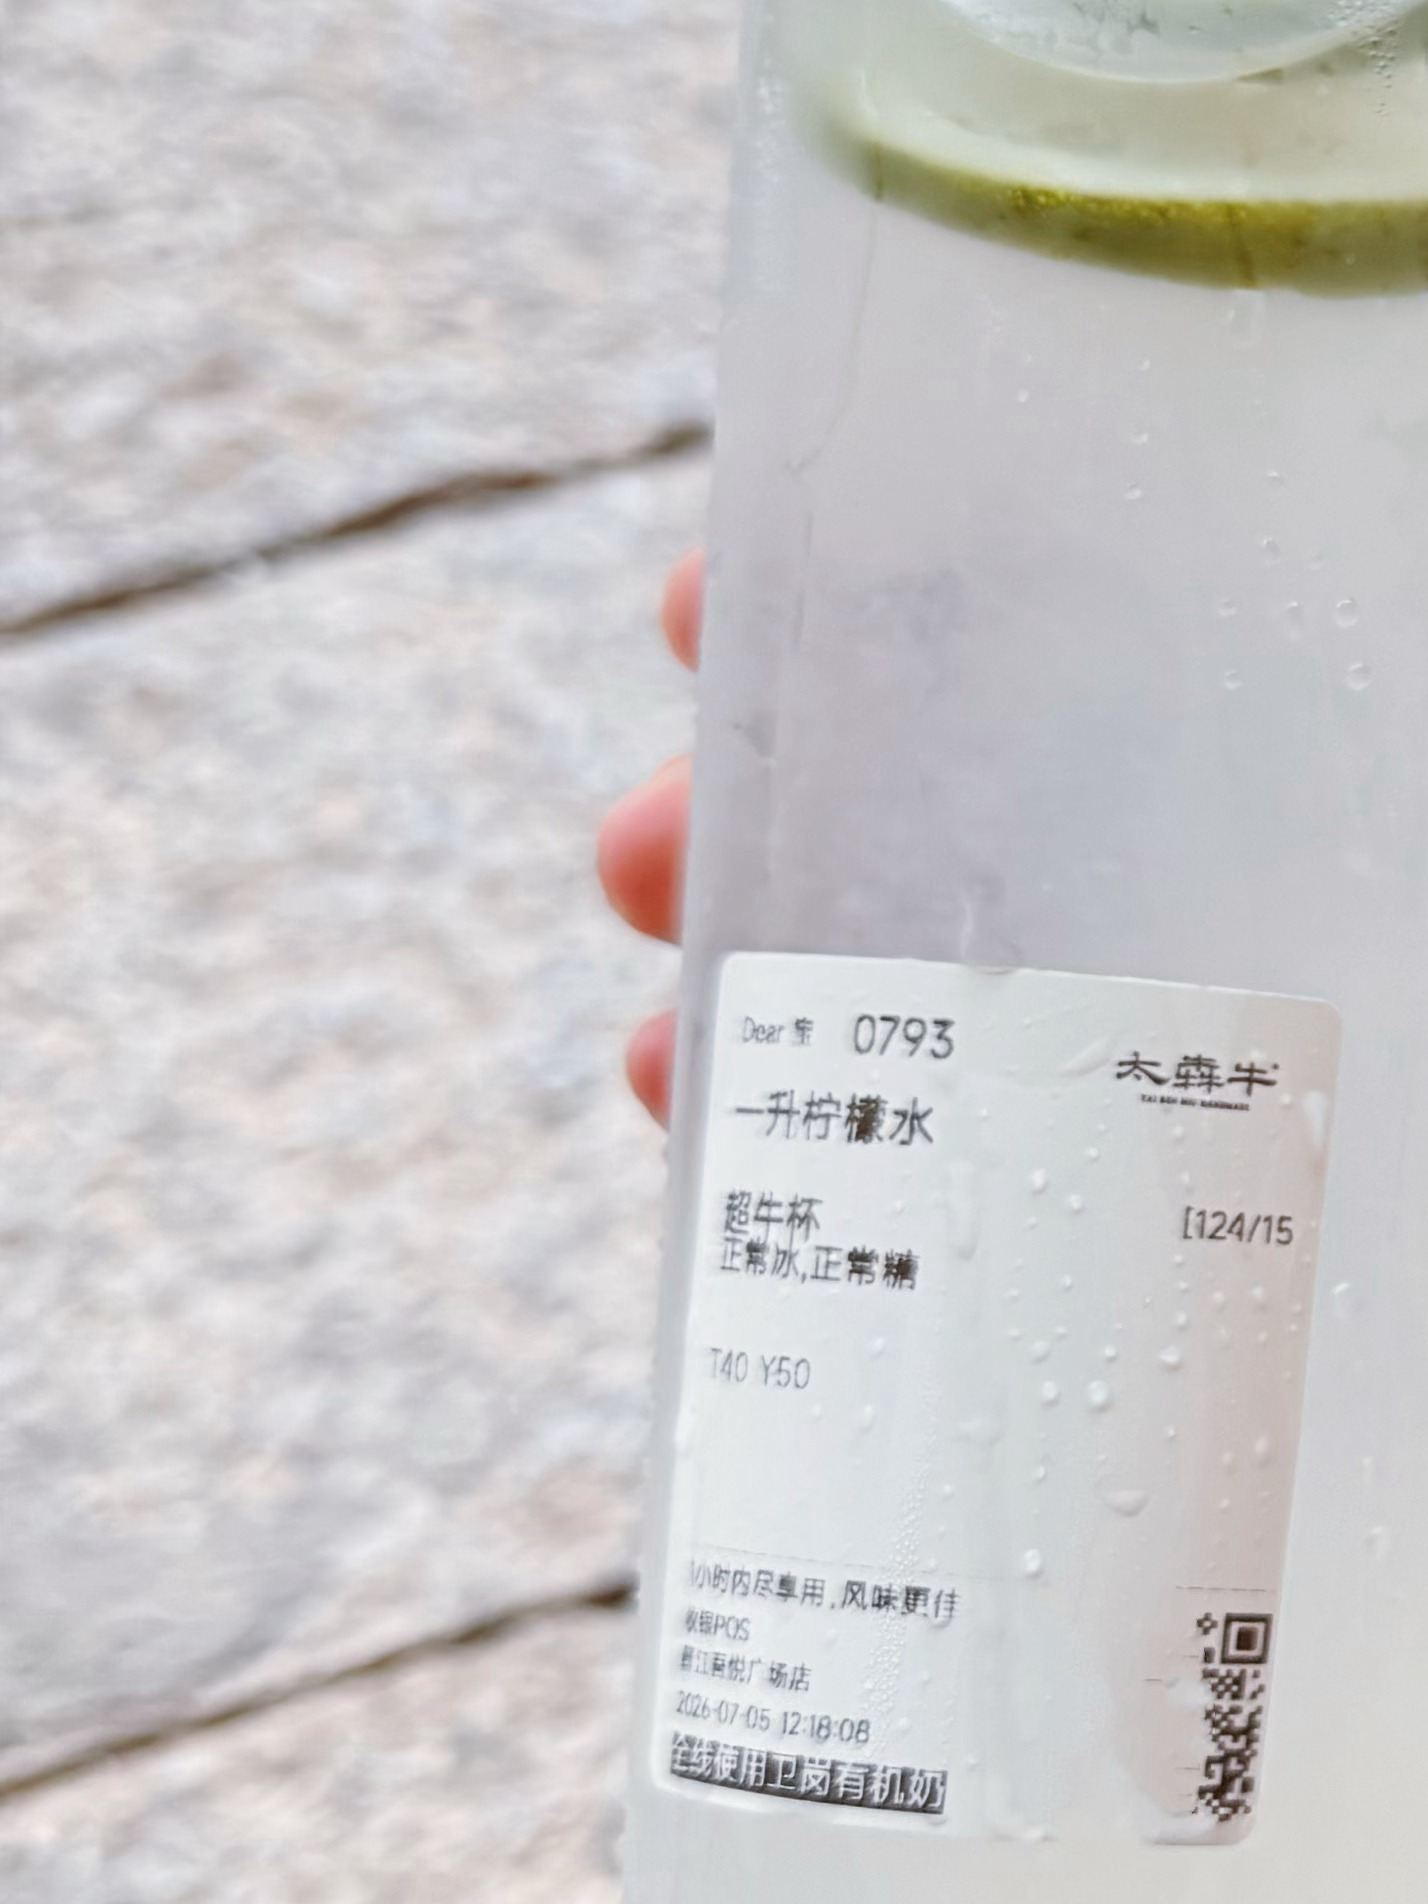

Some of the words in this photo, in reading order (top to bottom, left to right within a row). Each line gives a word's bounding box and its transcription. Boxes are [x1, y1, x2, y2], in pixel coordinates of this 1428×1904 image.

[742, 1015, 785, 1044] Dear
[853, 1014, 956, 1059] 0793
[734, 1089, 934, 1146] 一升柠檬水
[724, 1190, 823, 1242] 超牛杯
[711, 1348, 749, 1383] T40
[761, 1354, 811, 1389] Y50
[676, 1690, 771, 1732] 2026-07-05
[782, 1711, 871, 1744] 12:18:08
[670, 1730, 949, 1815] 全线使用卫岗有机奶
